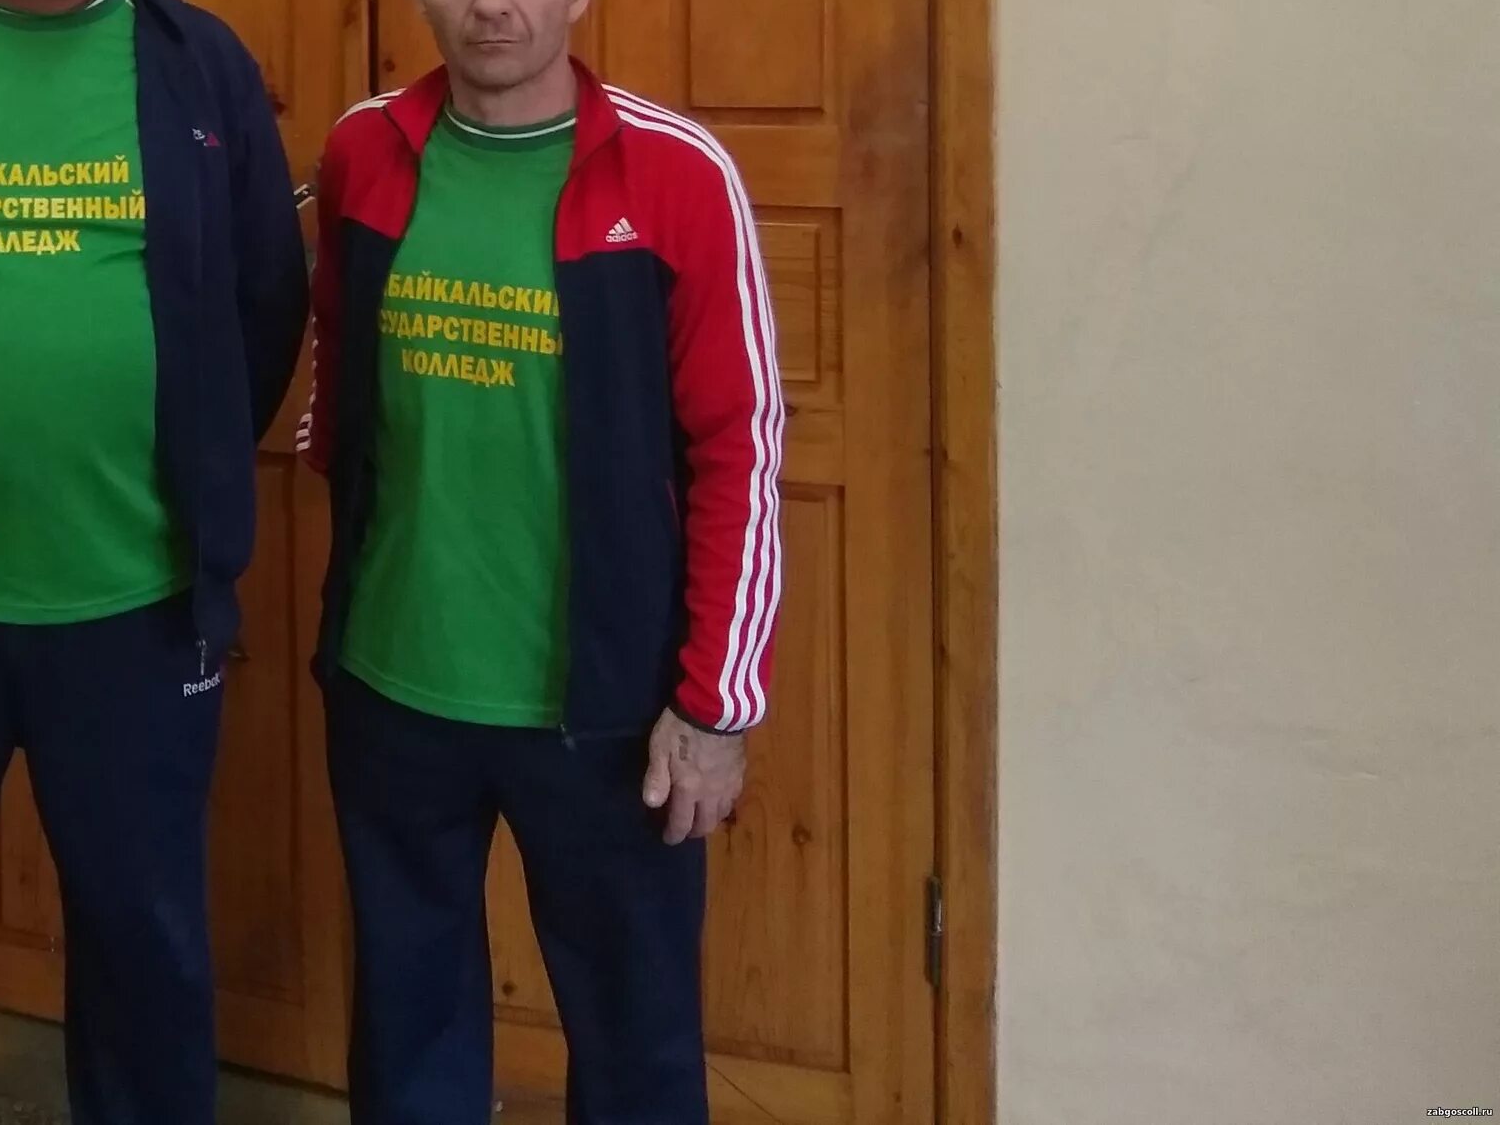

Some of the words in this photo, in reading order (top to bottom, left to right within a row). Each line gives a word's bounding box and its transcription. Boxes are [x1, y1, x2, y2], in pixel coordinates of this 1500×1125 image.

[605, 230, 639, 243] adidas
[383, 270, 560, 317] БАЙКАЛЬСКИ
[401, 349, 516, 388] КОЛЛЕДЖ
[182, 672, 221, 698] Reebok
